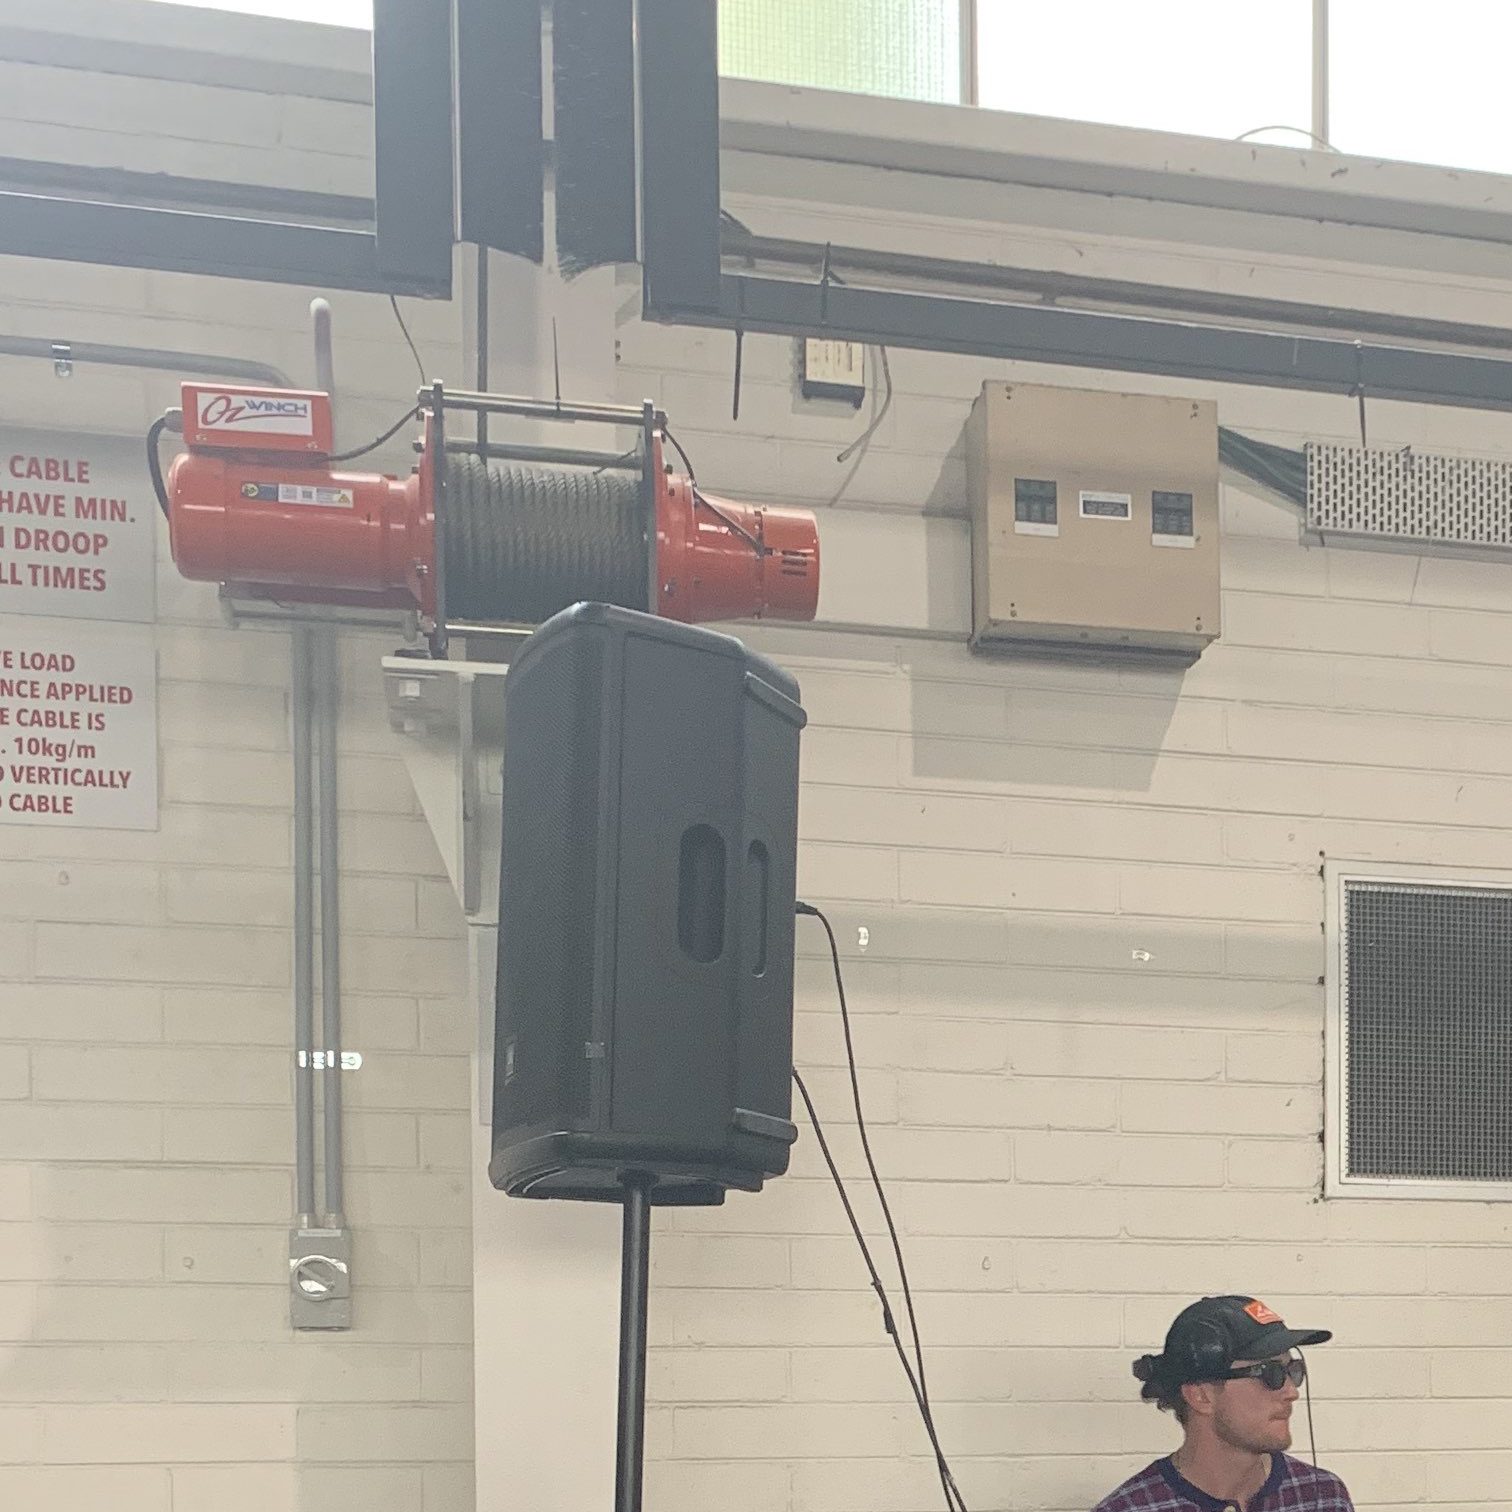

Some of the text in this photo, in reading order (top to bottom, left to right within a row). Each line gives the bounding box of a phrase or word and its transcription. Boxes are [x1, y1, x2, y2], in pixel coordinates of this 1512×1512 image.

[245, 400, 307, 414] WINCH
[9, 455, 90, 484] CABLE
[0, 490, 136, 523] HAVE MIN.
[14, 527, 109, 555] DROOP
[27, 564, 106, 592] TIMES
[20, 652, 75, 672] LOAD
[46, 682, 133, 704] APPLIED
[16, 708, 80, 730] CABLE
[87, 713, 106, 731] IS
[14, 737, 96, 762] 10kg/m
[11, 765, 131, 788] VERTICALLY
[9, 793, 74, 814] CABLE
